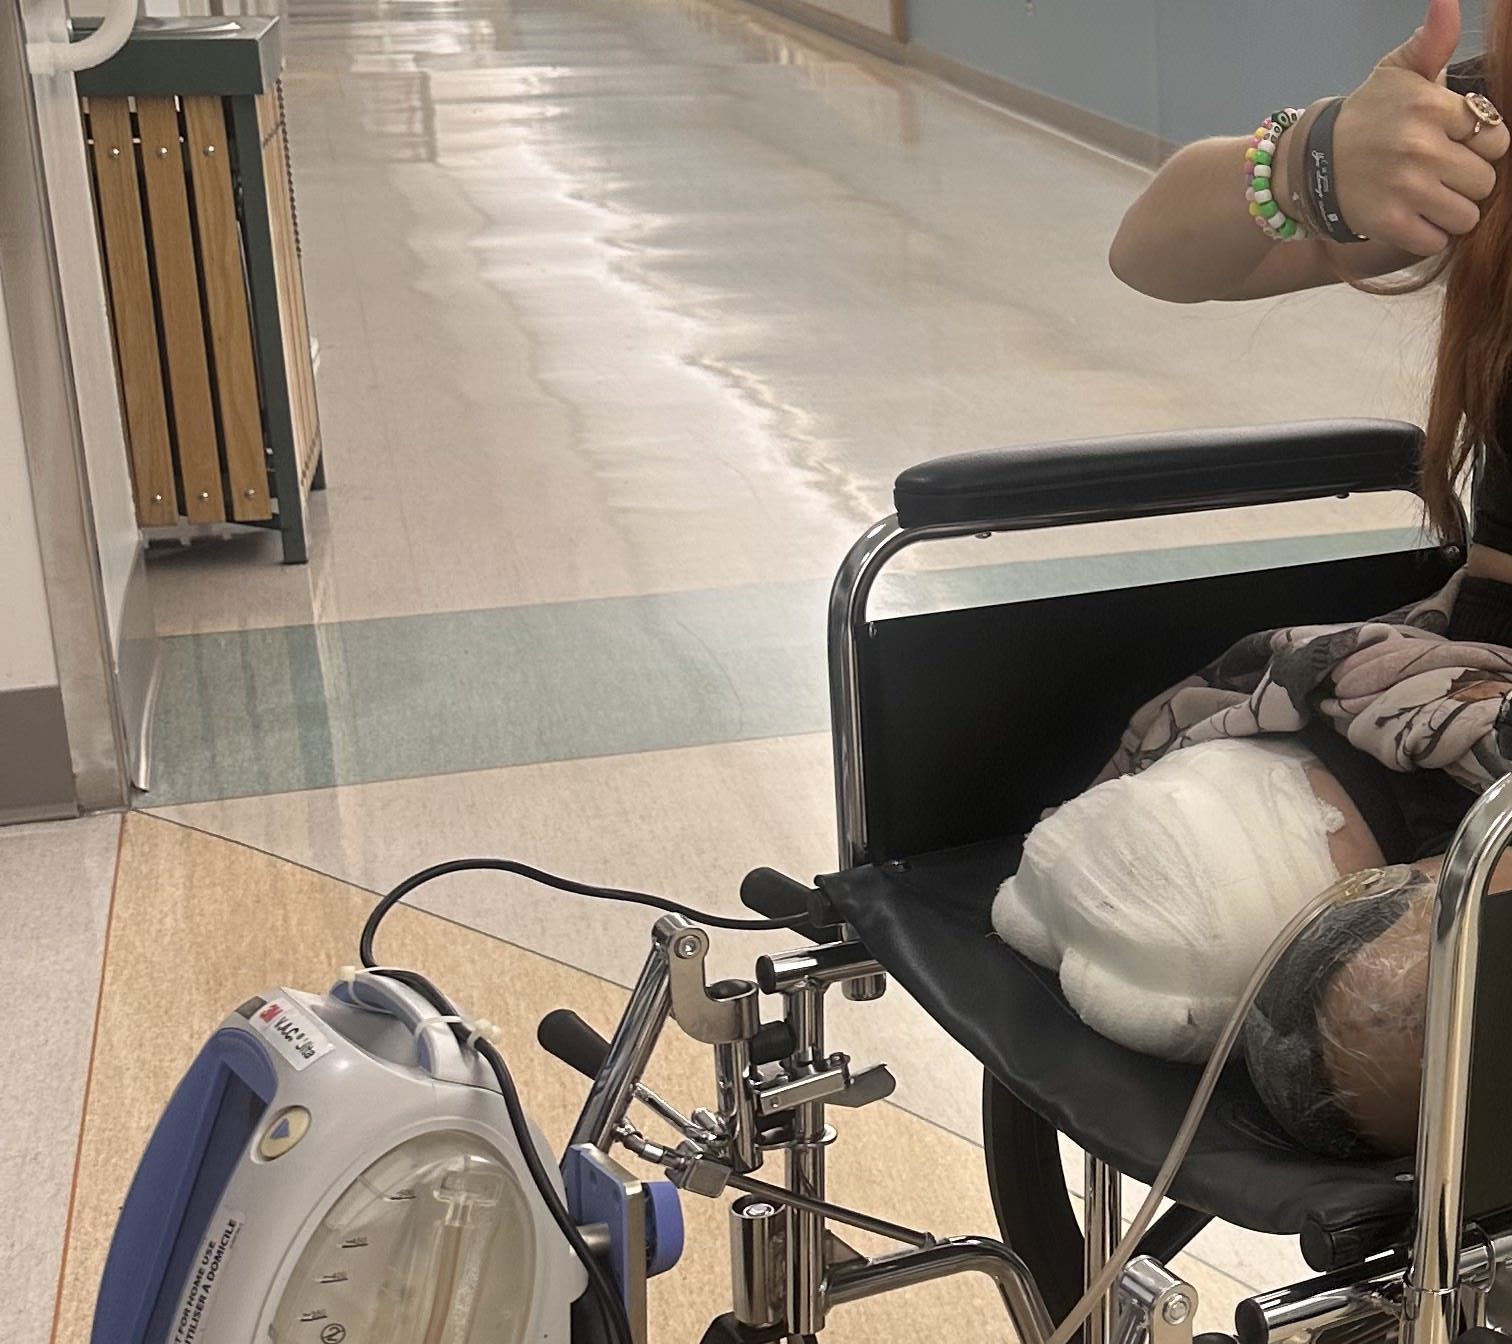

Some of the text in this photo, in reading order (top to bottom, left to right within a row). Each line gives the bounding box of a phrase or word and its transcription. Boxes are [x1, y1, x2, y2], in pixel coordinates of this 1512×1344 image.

[177, 1307, 191, 1335] FOR
[188, 1266, 206, 1306] HOME
[202, 1240, 217, 1266] USE
[207, 1218, 237, 1282] DOMICILE
